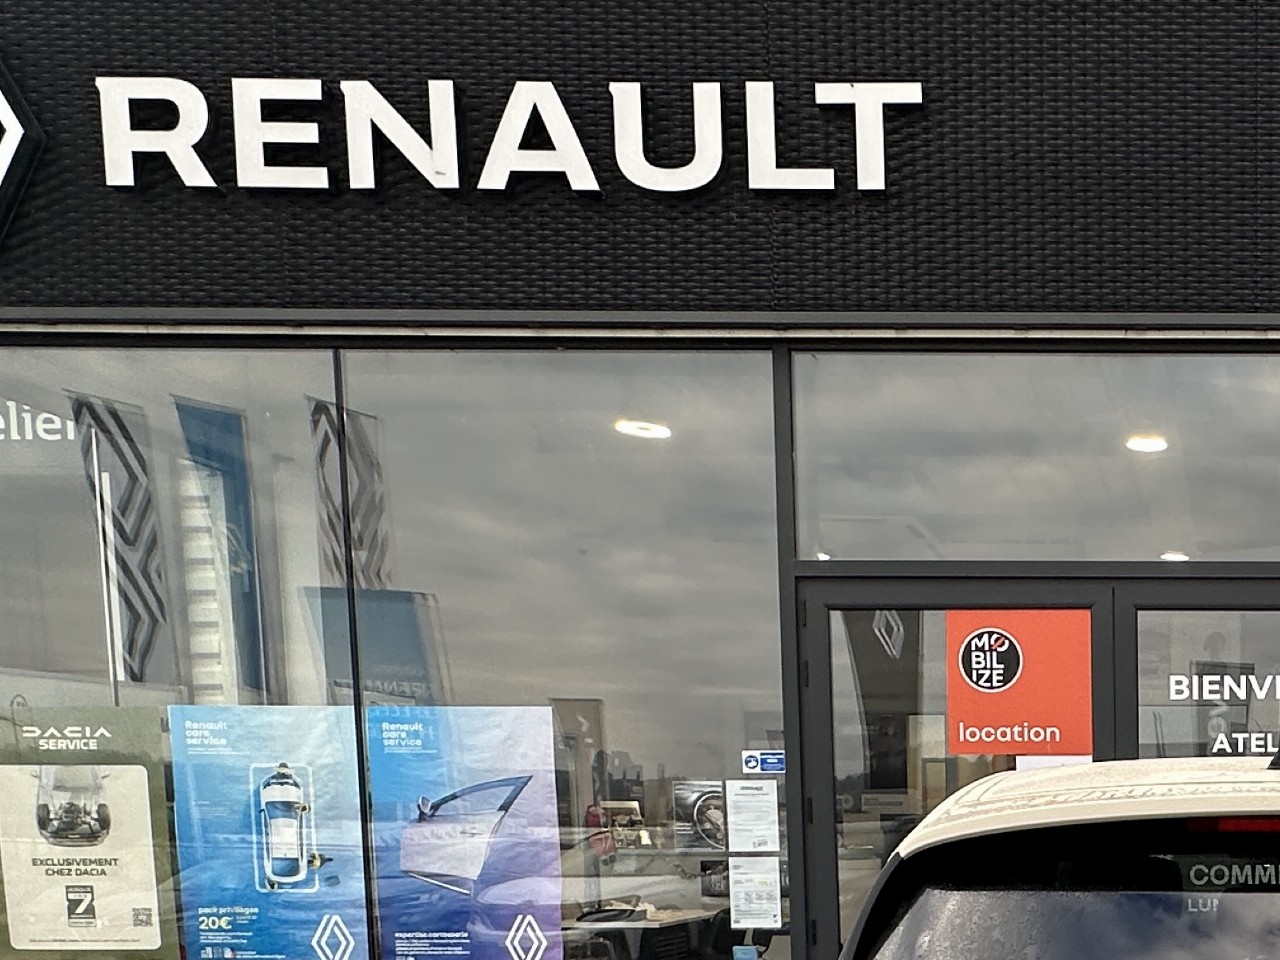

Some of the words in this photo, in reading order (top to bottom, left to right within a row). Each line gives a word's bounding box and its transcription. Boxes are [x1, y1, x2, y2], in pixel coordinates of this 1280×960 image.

[95, 76, 923, 192] RENAULT
[185, 720, 228, 730] Renault
[382, 722, 424, 731] Renault
[22, 726, 112, 737] DACIA
[959, 721, 1061, 743] location
[38, 738, 98, 750] SERVICE
[186, 737, 227, 745] service
[383, 738, 422, 746] service
[31, 857, 119, 867] EXCLUSIVEMENT
[45, 868, 73, 877] CHEZ
[74, 868, 107, 877] DACIA
